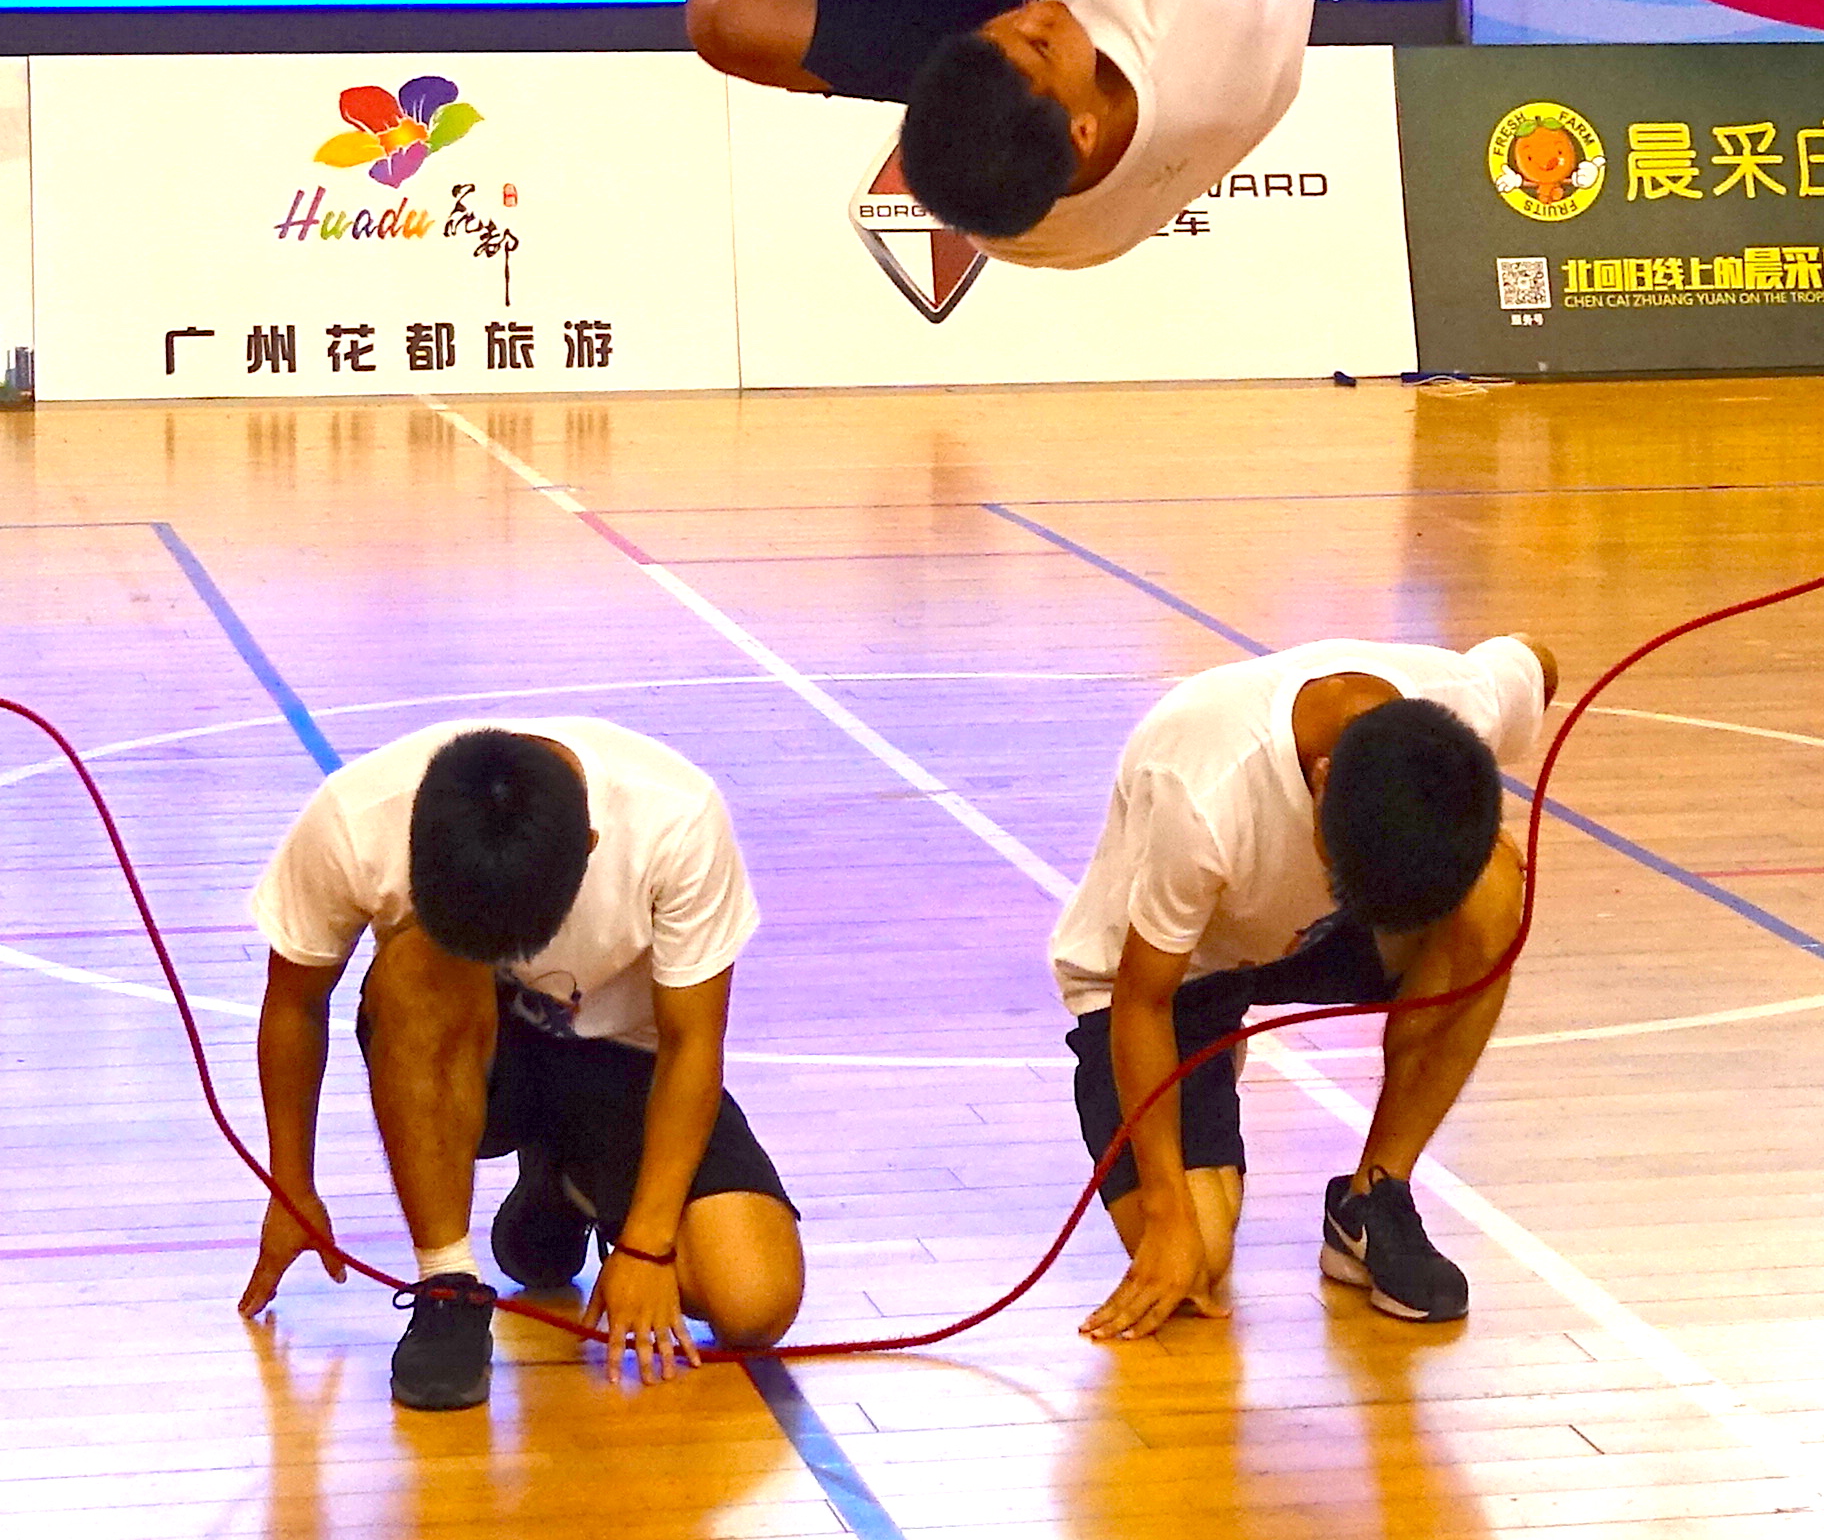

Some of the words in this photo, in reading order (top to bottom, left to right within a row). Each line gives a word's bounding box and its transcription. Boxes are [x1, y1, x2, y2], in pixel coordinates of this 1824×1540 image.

[1492, 111, 1527, 157] FRESH
[1558, 110, 1595, 148] FARM
[274, 185, 436, 242] Huadu
[1523, 199, 1579, 218] FRUITS
[1563, 293, 1604, 308] CHEN
[1605, 293, 1630, 307] CAI
[1631, 292, 1693, 306] ZHUANG
[1693, 291, 1736, 305] YUAN
[1739, 291, 1760, 304] ON
[1763, 291, 1787, 304] THE
[164, 321, 614, 375] 广州花都旅游
